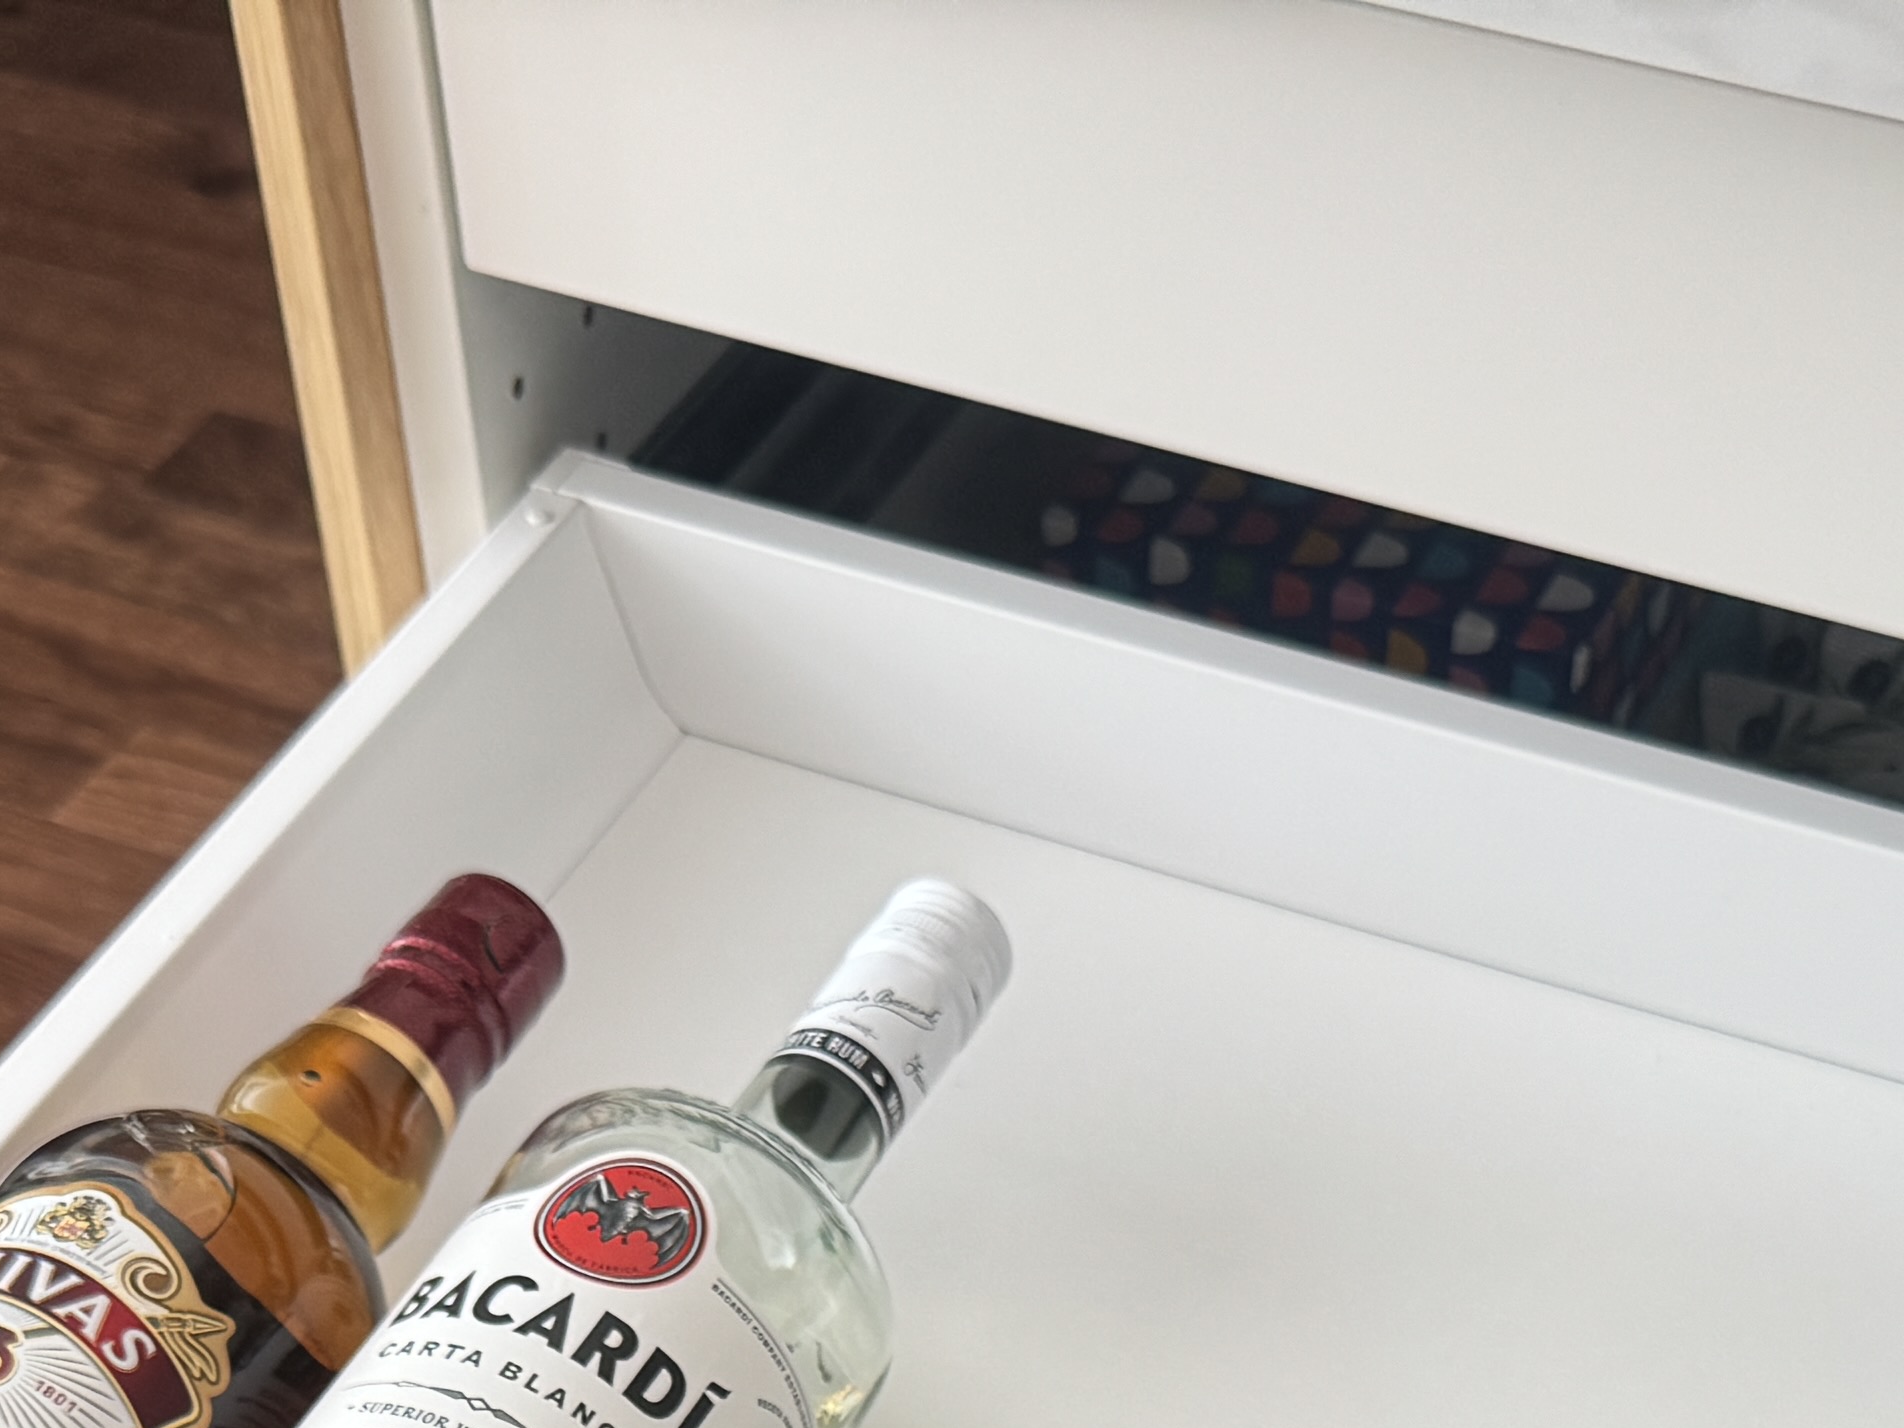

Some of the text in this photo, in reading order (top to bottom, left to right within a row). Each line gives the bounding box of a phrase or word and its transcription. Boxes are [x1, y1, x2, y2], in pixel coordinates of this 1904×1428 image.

[827, 1036, 870, 1070] RUM
[378, 1341, 483, 1368] CARTA
[35, 1379, 78, 1414] 1801
